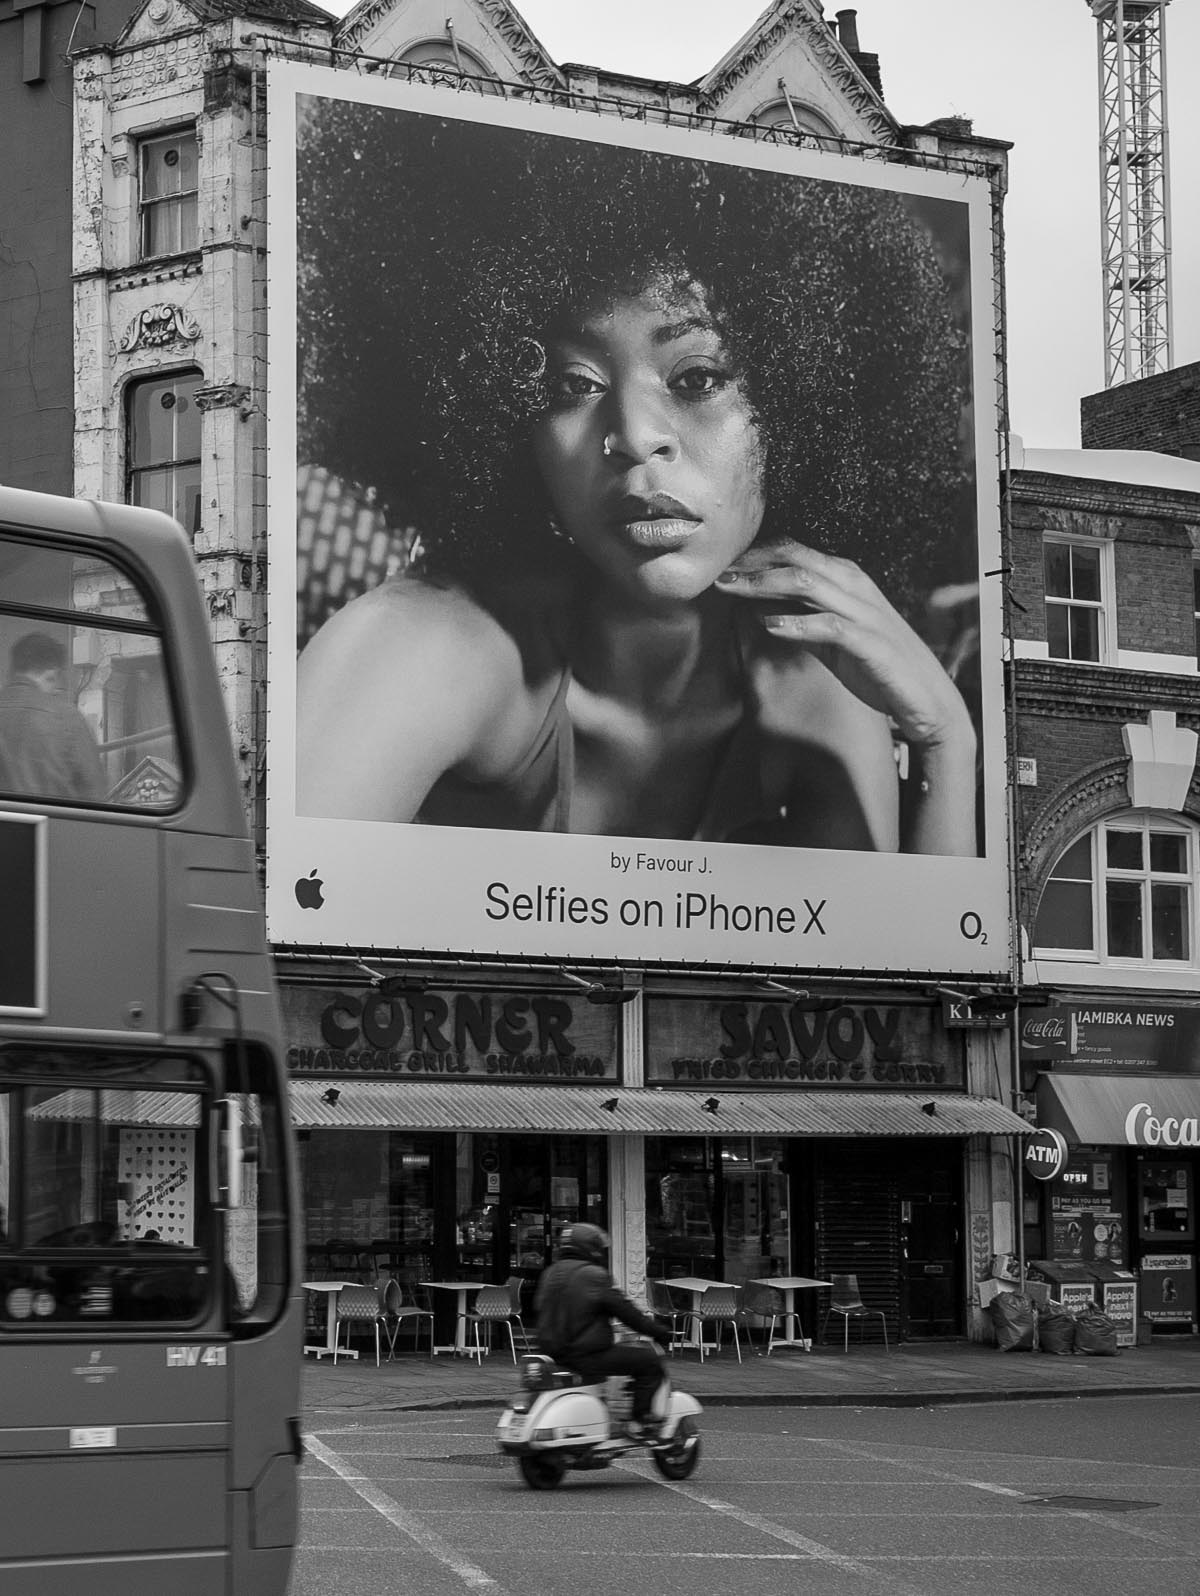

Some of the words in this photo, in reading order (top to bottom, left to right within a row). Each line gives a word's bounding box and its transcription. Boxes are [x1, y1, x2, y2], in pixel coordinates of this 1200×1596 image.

[610, 851, 631, 873] by
[636, 853, 694, 873] Favour
[698, 857, 713, 874] J.
[485, 881, 609, 925] Selfies
[619, 899, 663, 927] on
[320, 992, 576, 1055] CORNER
[1136, 1013, 1175, 1027] NEWS
[720, 1003, 901, 1062] SAVOY
[407, 1051, 469, 1074] GRILL
[486, 1053, 605, 1077] SHAWARMA
[671, 1058, 741, 1080] FRIED
[746, 1058, 843, 1081] CHICKEN
[872, 1061, 946, 1084] CURRY
[1025, 1145, 1058, 1164] ATM
[1063, 1173, 1088, 1184] OPEN
[1106, 1291, 1135, 1302] Apple's
[1109, 1302, 1129, 1311] next
